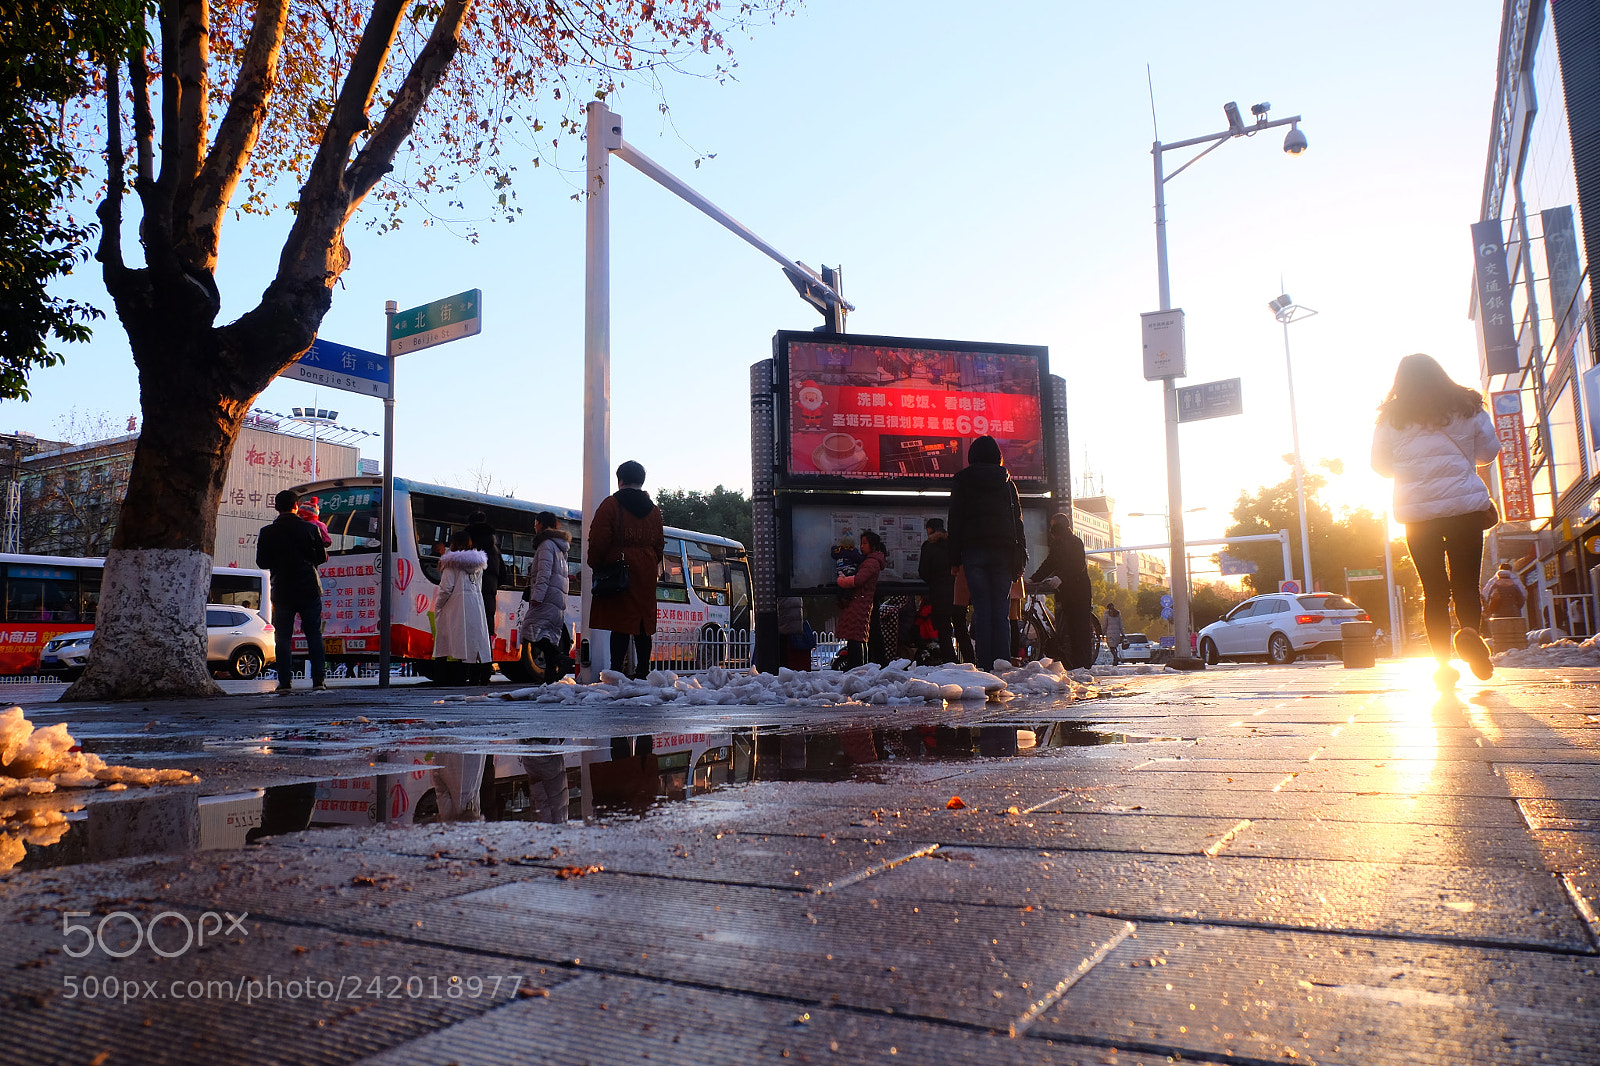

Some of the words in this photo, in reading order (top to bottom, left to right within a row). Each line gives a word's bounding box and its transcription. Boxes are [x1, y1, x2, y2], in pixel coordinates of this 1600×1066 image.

[414, 303, 452, 329] 北街
[413, 332, 439, 346] Beijie
[300, 367, 342, 385] Dongjie
[372, 384, 379, 392] W
[336, 588, 353, 596] 文明
[336, 599, 353, 608] 公正
[358, 598, 375, 607] 法治
[336, 610, 353, 619] 诚信
